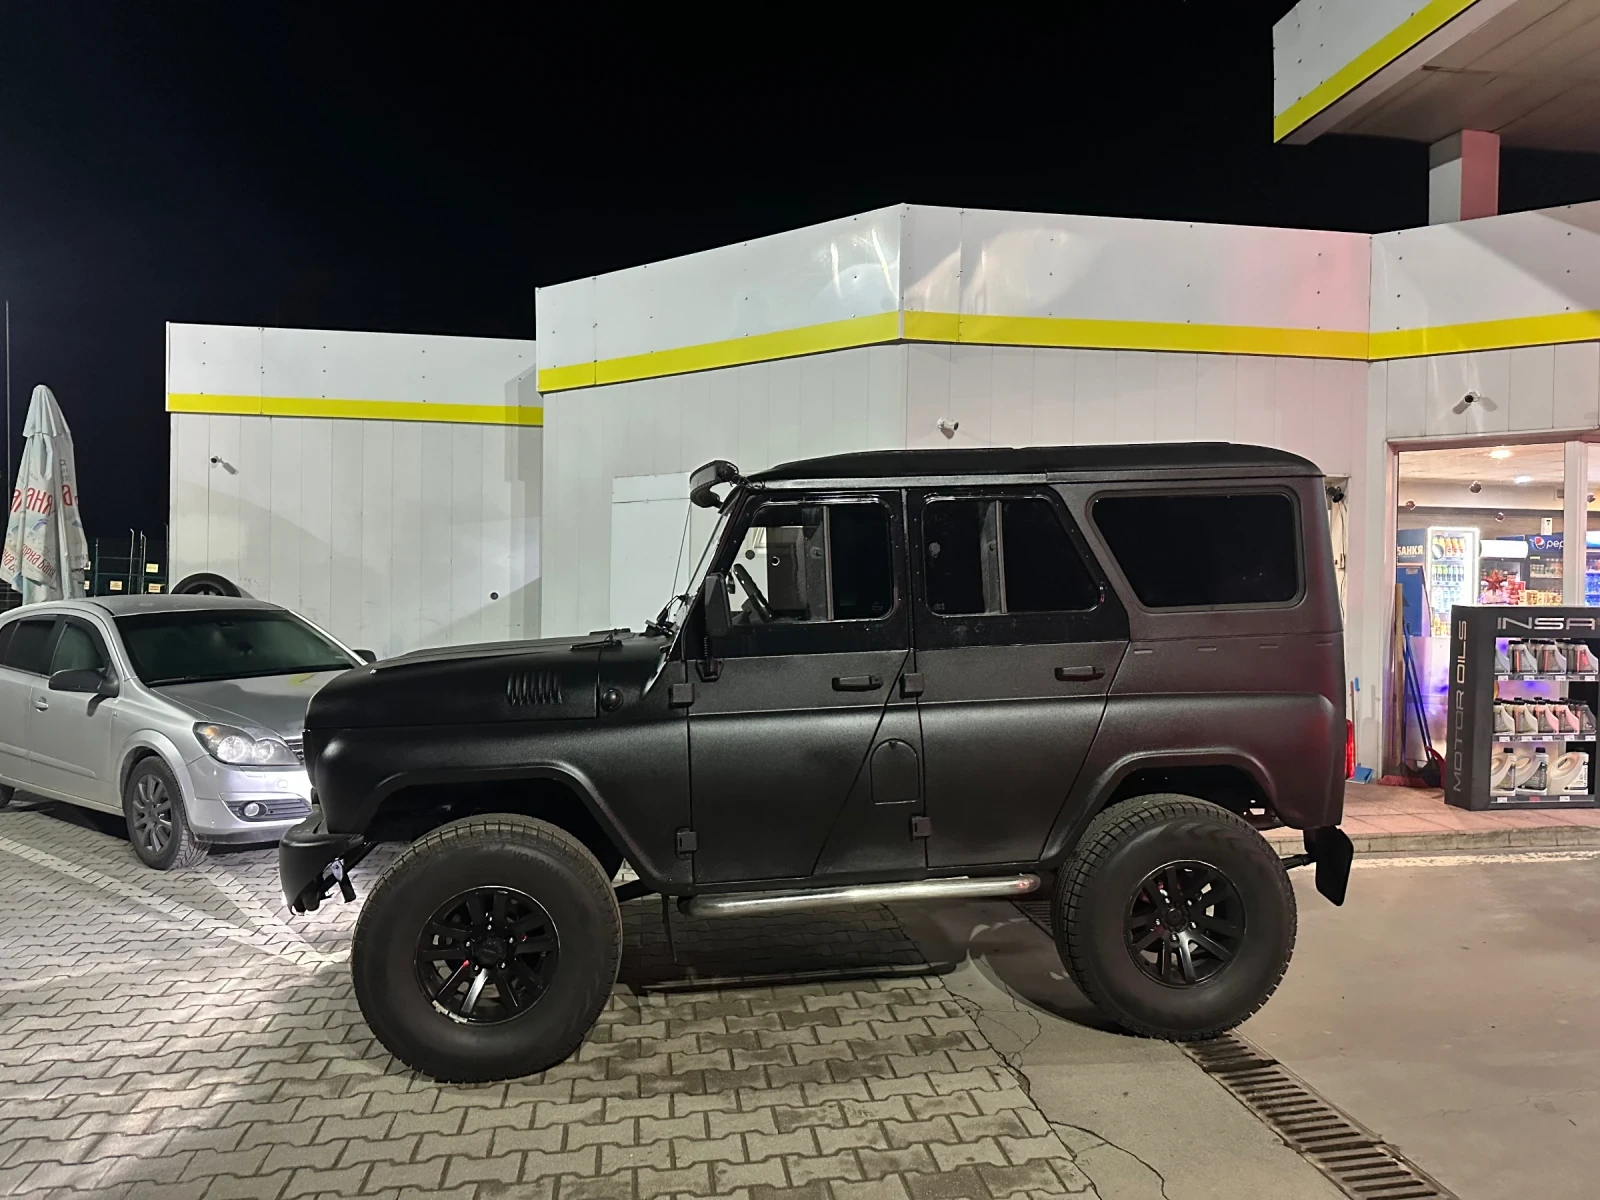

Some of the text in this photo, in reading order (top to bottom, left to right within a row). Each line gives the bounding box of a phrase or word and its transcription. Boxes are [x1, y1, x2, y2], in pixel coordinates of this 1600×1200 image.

[1546, 539, 1564, 549] pep
[1497, 617, 1600, 630] INSA
[1453, 620, 1467, 792] MOTOR OILS
[513, 851, 568, 885] YOKOH
